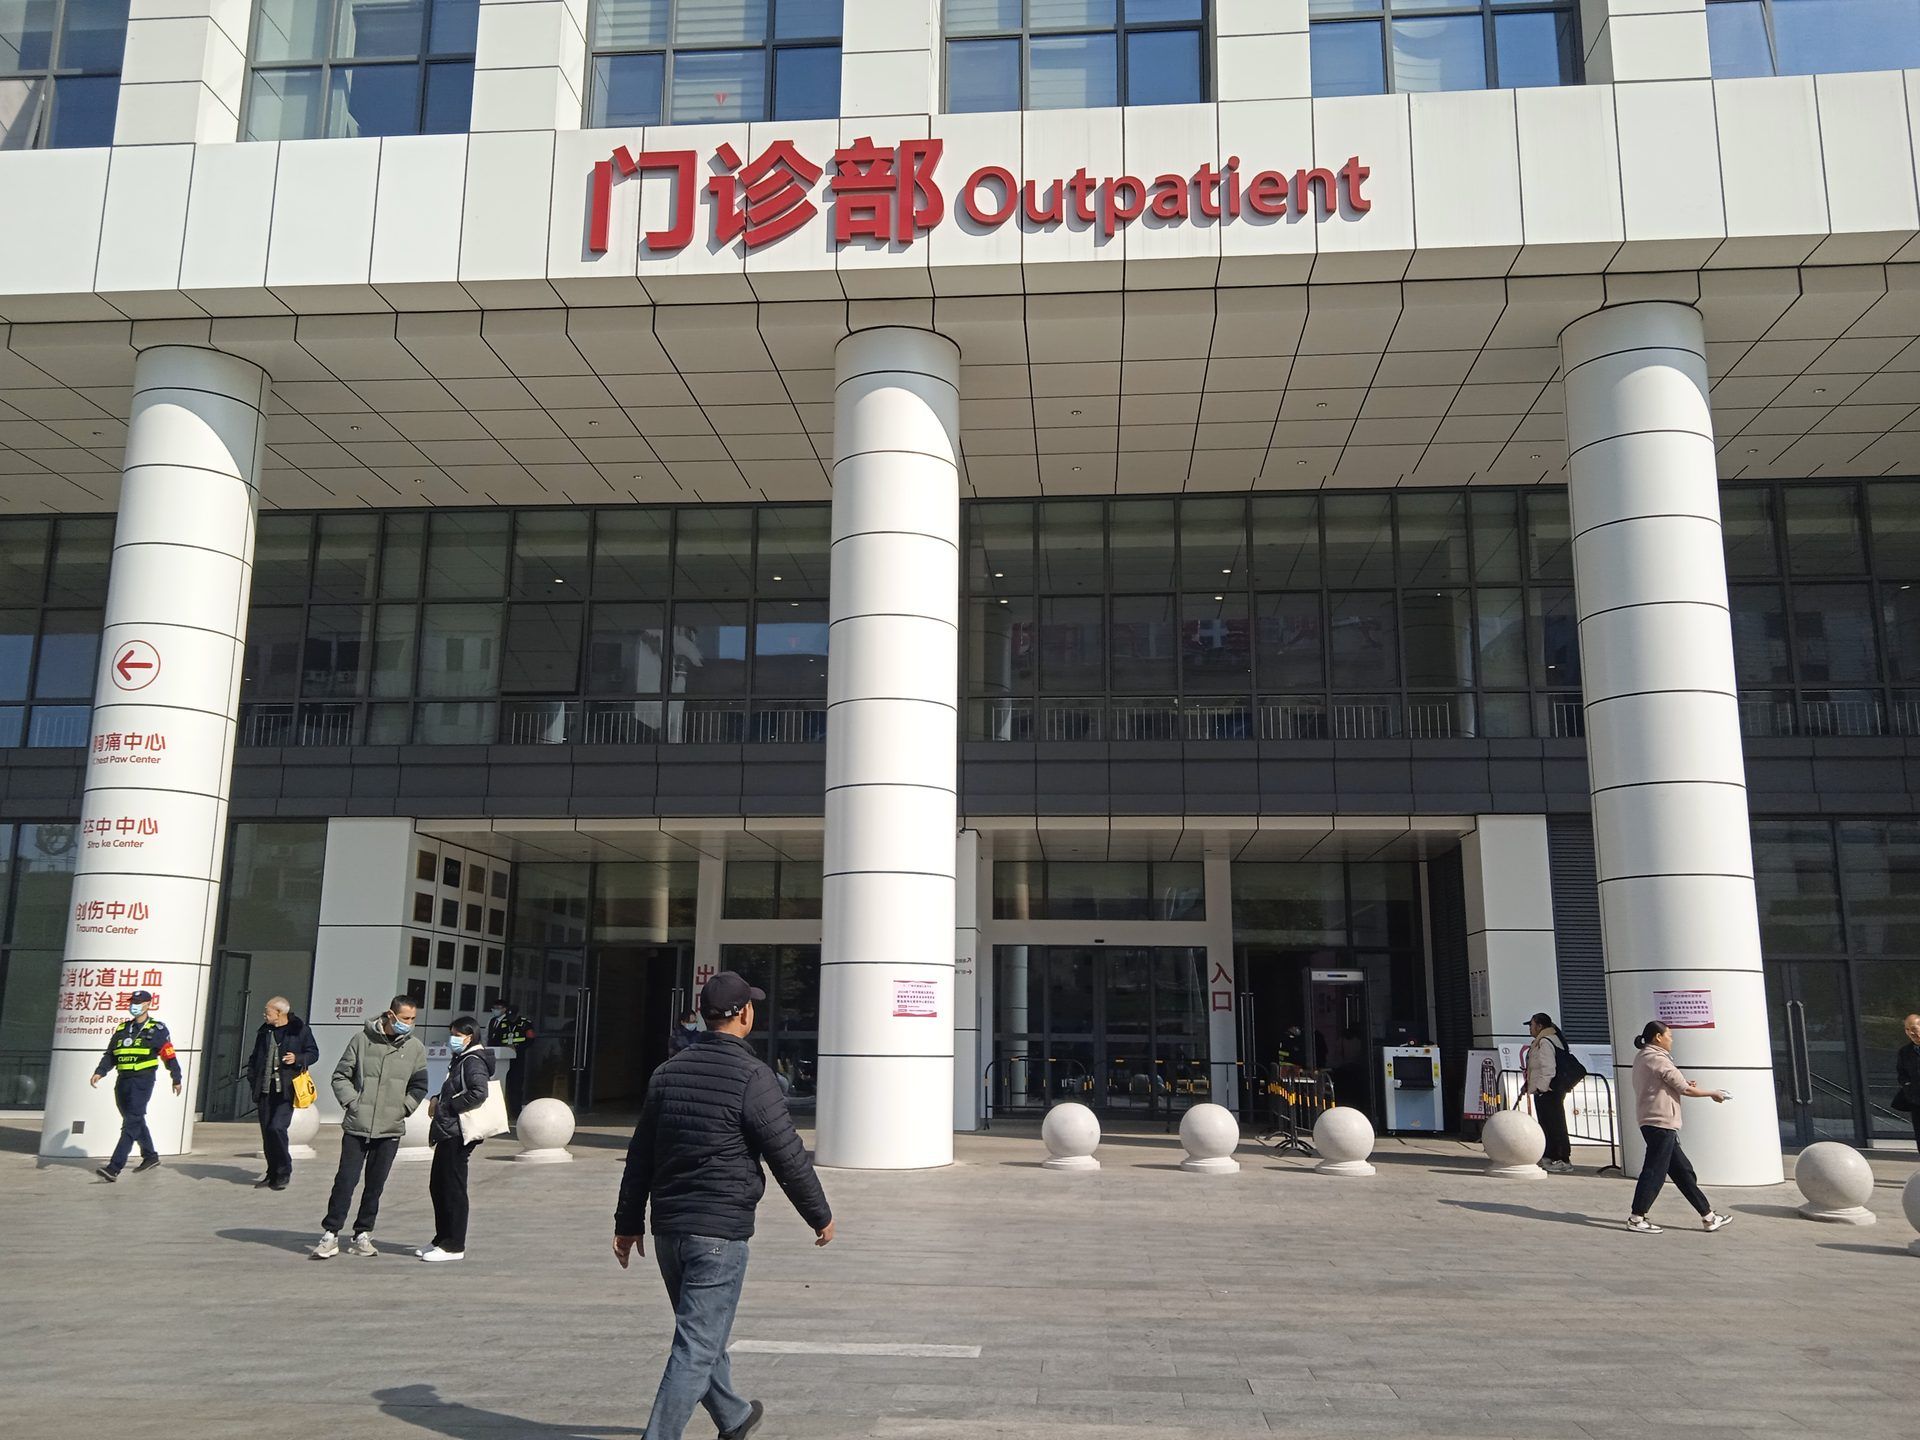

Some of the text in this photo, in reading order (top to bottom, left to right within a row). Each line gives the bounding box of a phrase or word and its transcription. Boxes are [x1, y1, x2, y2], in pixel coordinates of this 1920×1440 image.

[589, 136, 945, 252] 门诊部
[963, 155, 1371, 238] Outpatient
[129, 755, 161, 764] Center
[113, 840, 144, 848] Center
[76, 900, 149, 921] 创伤中心
[76, 924, 138, 934] Trauma Center
[695, 964, 714, 1012] 出
[1210, 962, 1232, 1011] 入口
[79, 1015, 104, 1025] Rapid
[104, 1026, 116, 1034] of
